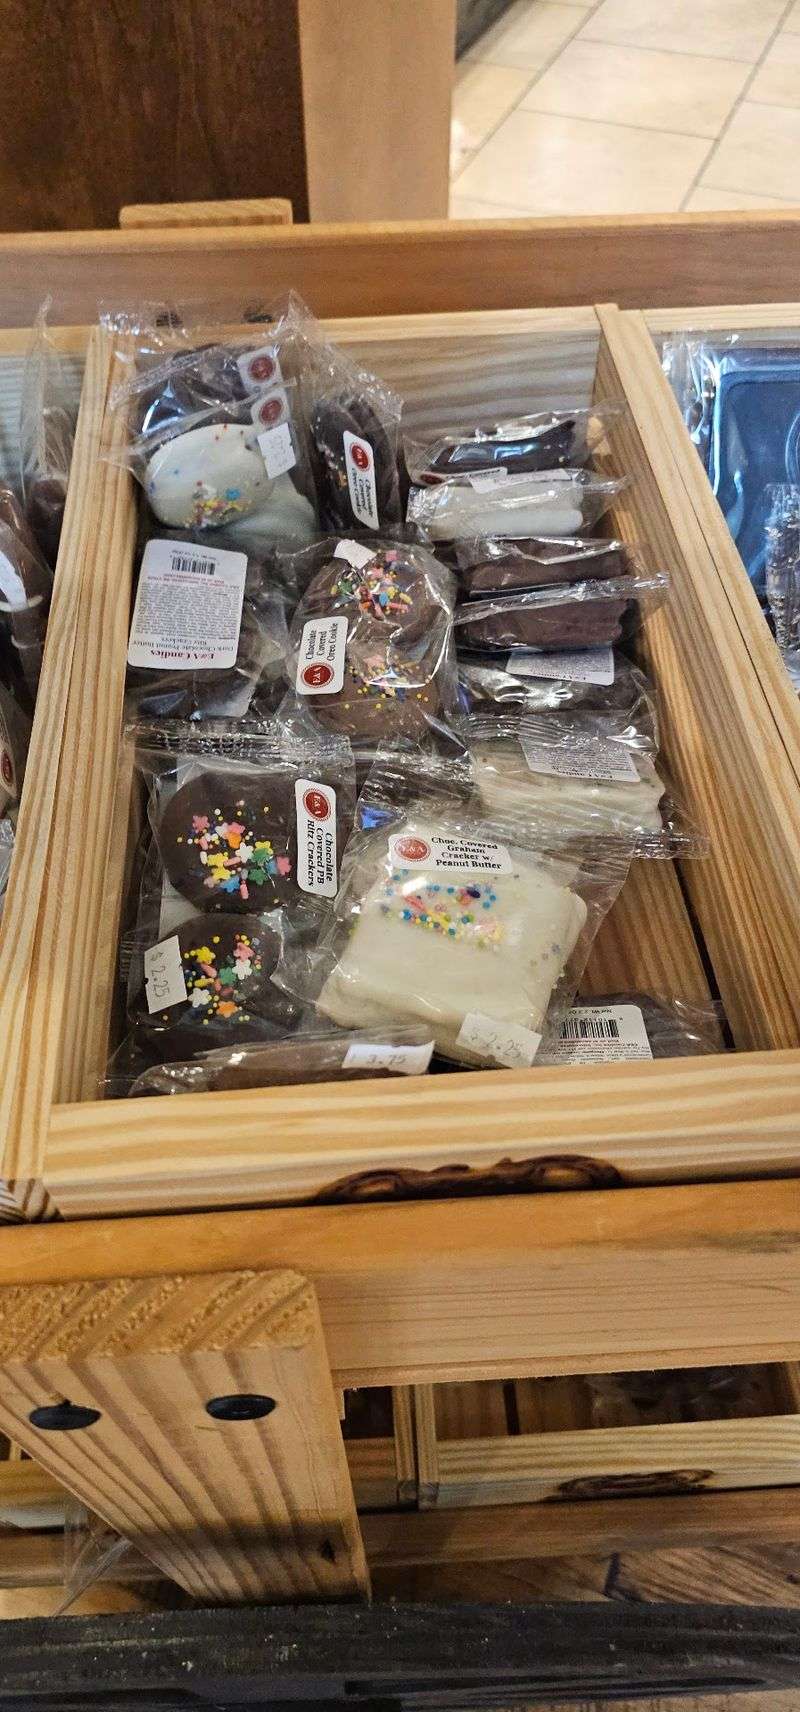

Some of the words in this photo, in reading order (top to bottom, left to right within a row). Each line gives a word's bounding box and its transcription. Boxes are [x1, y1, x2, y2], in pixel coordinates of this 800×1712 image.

[329, 623, 338, 643] Cookie
[306, 630, 316, 660] Chocolate
[317, 630, 327, 656] Covered
[327, 643, 337, 661] Oreo
[150, 650, 192, 659] Candies
[307, 820, 315, 839] Ritz
[316, 827, 325, 870] Covered
[432, 836, 458, 845] Choc.
[460, 840, 498, 850] Covered
[447, 844, 486, 854] Graham
[307, 841, 315, 886] Crackers
[325, 832, 333, 882] Chocolate
[435, 859, 470, 868] Peanut
[472, 861, 502, 870] Butter
[441, 852, 479, 860] Cracker
[317, 871, 325, 884] PB
